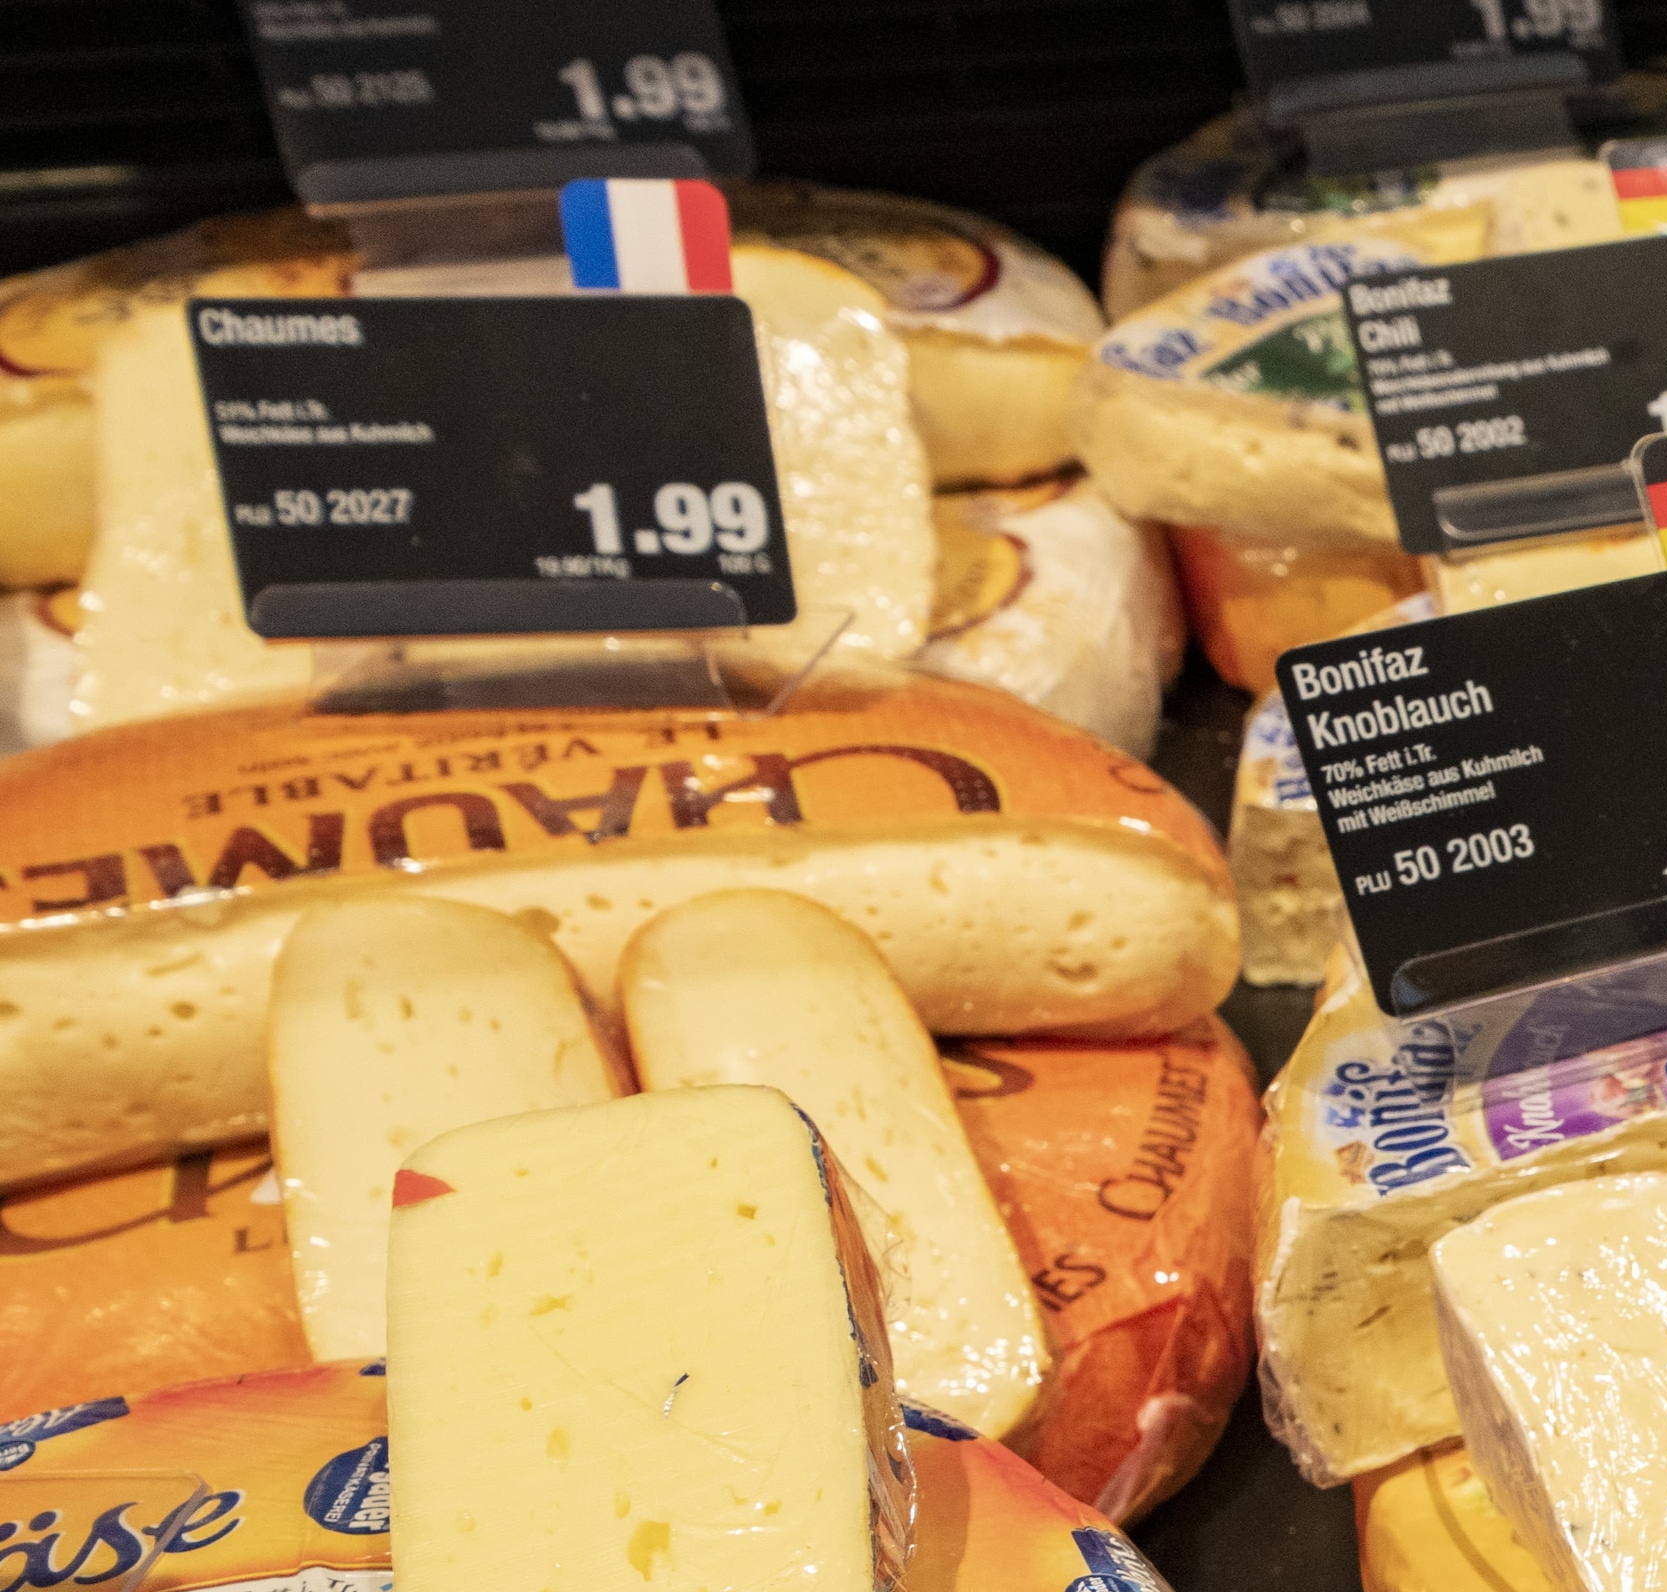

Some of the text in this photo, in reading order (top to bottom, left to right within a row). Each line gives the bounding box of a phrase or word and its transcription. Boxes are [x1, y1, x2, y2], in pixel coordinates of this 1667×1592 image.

[558, 53, 728, 121] 1.99
[1349, 276, 1453, 316] Bonifaz
[199, 308, 365, 346] Chaumes
[1358, 315, 1423, 353] Chili
[1415, 425, 1455, 459] 50
[274, 489, 322, 525] 50
[326, 488, 414, 525] 2027
[573, 481, 769, 556] 1.99
[1291, 646, 1431, 700] Bonifaz
[1307, 679, 1495, 750] Knoblauch
[1321, 760, 1365, 785] 70%
[1365, 750, 1405, 775] Fett
[1327, 744, 1545, 810] Weichkäse aus Kuhmilch
[1337, 779, 1497, 834] mit Weißschimmel
[1356, 823, 1535, 896] PLU 50 2003
